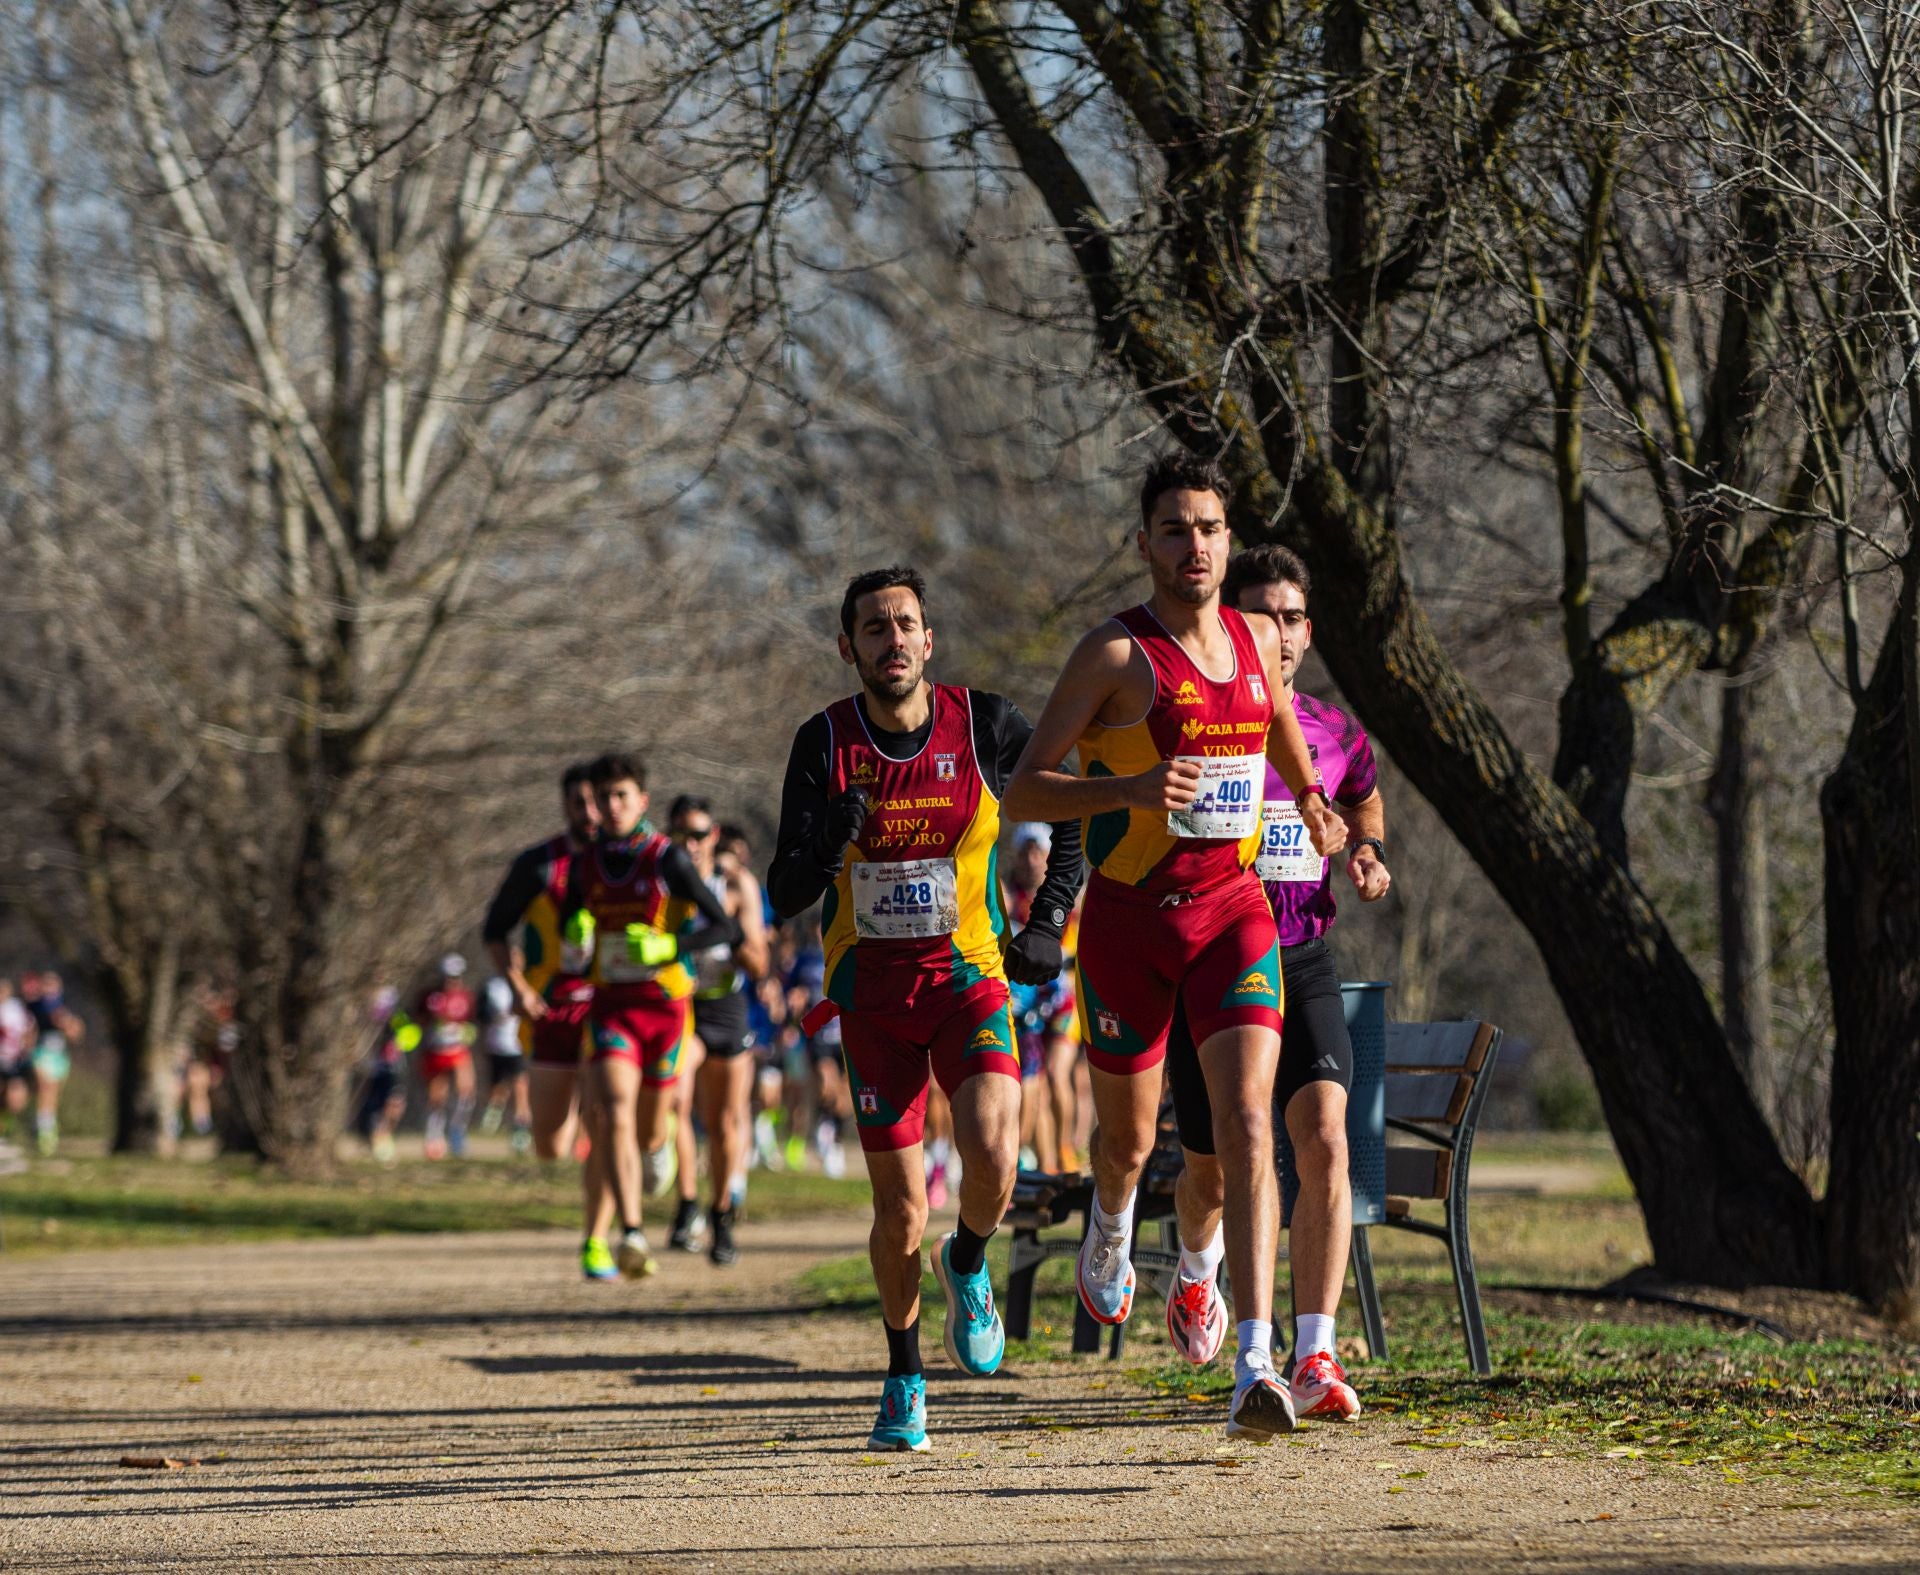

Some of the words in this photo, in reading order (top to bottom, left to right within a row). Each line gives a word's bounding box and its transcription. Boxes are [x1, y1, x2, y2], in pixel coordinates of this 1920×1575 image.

[1206, 724, 1233, 735] CAJA
[1235, 722, 1265, 734] RURAL
[1203, 744, 1245, 758] VINO
[1217, 779, 1251, 803] 400
[884, 799, 913, 810] CAJA
[915, 797, 953, 808] RURAL
[883, 818, 929, 832] VINO
[870, 835, 892, 848] DE
[896, 832, 945, 846] TORO
[1268, 824, 1303, 847] 537
[892, 882, 931, 905] 428
